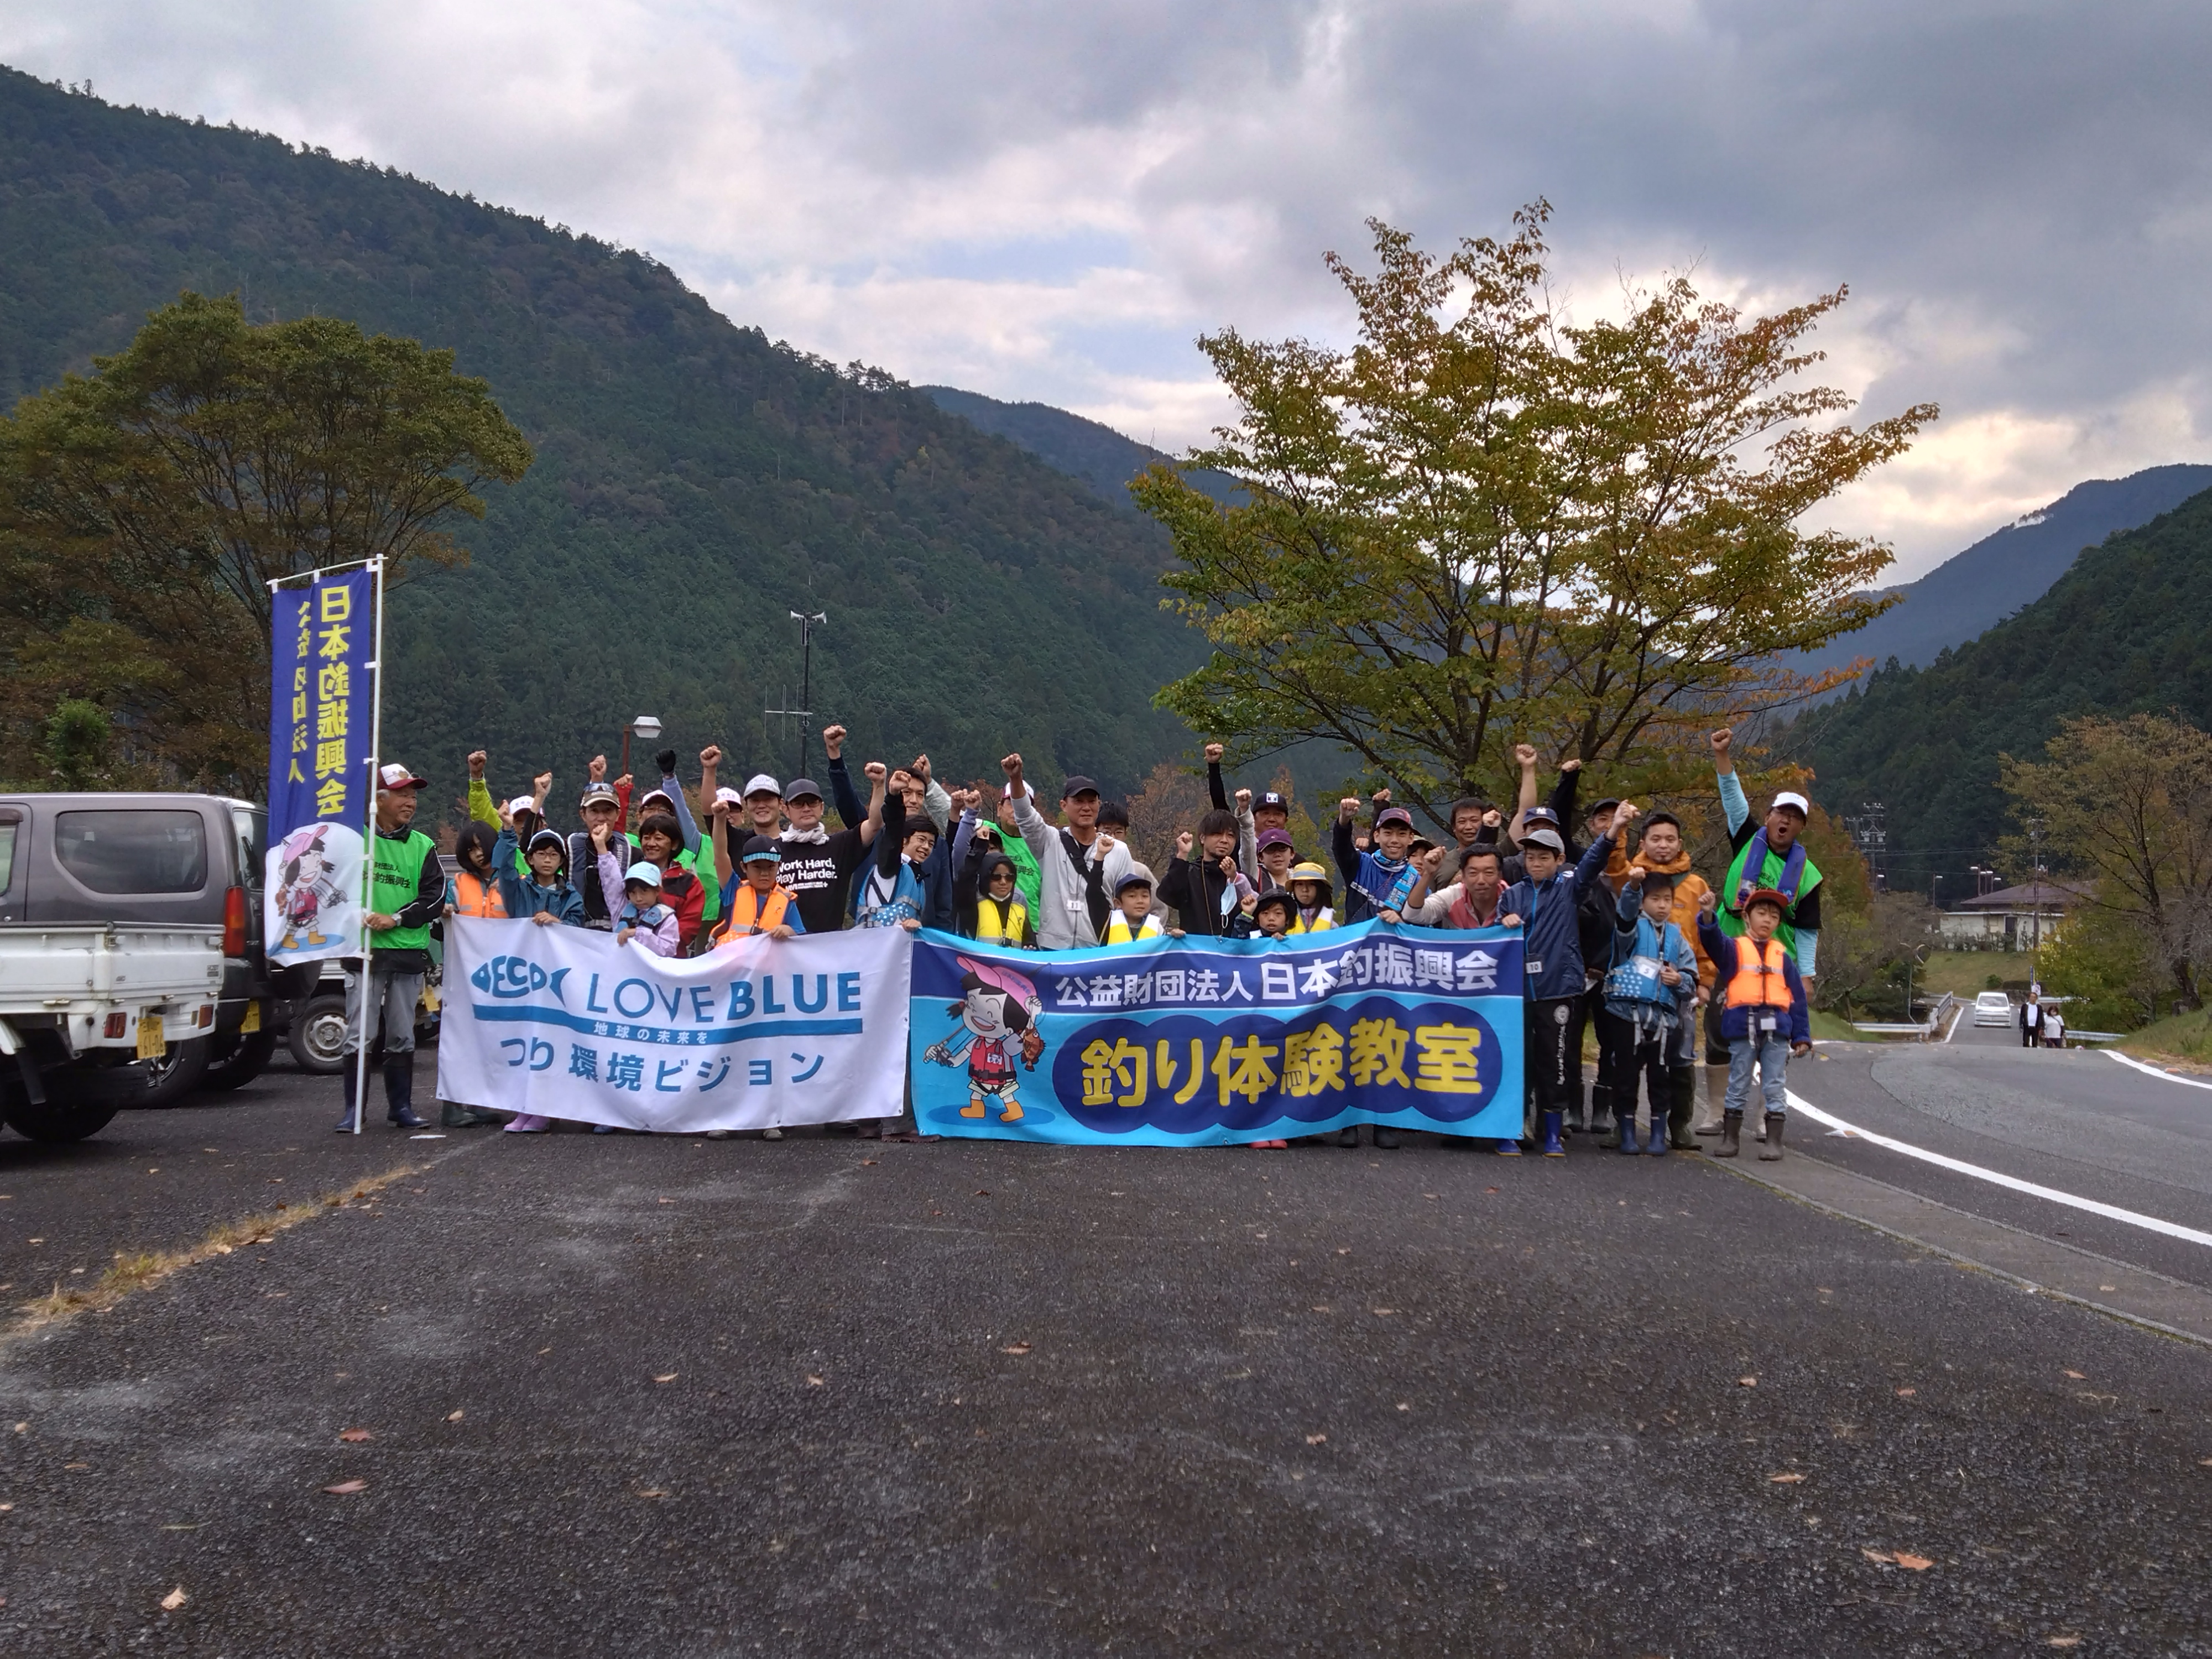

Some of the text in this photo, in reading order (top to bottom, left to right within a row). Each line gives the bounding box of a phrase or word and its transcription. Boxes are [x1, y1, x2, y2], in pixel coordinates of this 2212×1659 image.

[777, 858, 836, 874] Work Hard,
[798, 868, 837, 880] Harder.
[587, 973, 714, 1023] LOVE
[727, 972, 861, 1020] BLUE
[593, 1021, 708, 1045] 地球の未来を
[1081, 1018, 1483, 1107] 釣り体験教室
